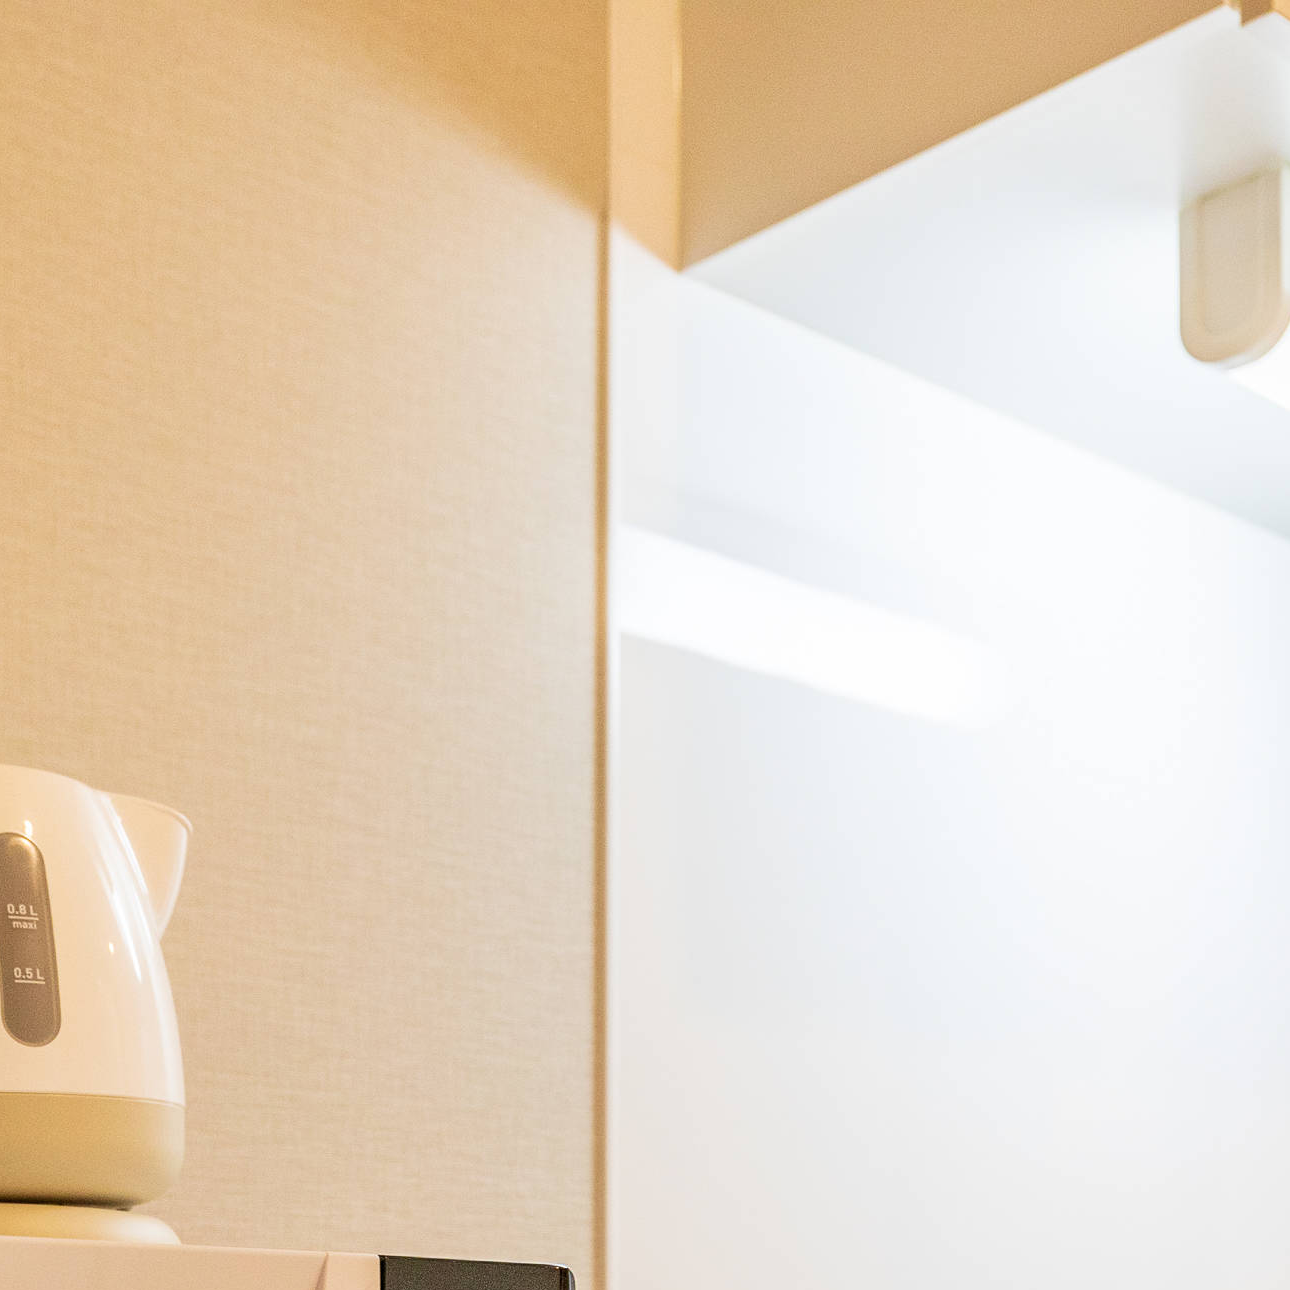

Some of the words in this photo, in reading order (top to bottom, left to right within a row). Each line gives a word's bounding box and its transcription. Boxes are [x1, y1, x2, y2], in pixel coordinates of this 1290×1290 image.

[7, 903, 27, 915] 0.8
[30, 905, 38, 916] L
[12, 921, 37, 929] maxi
[13, 967, 33, 979] 0.5
[36, 968, 45, 980] L
